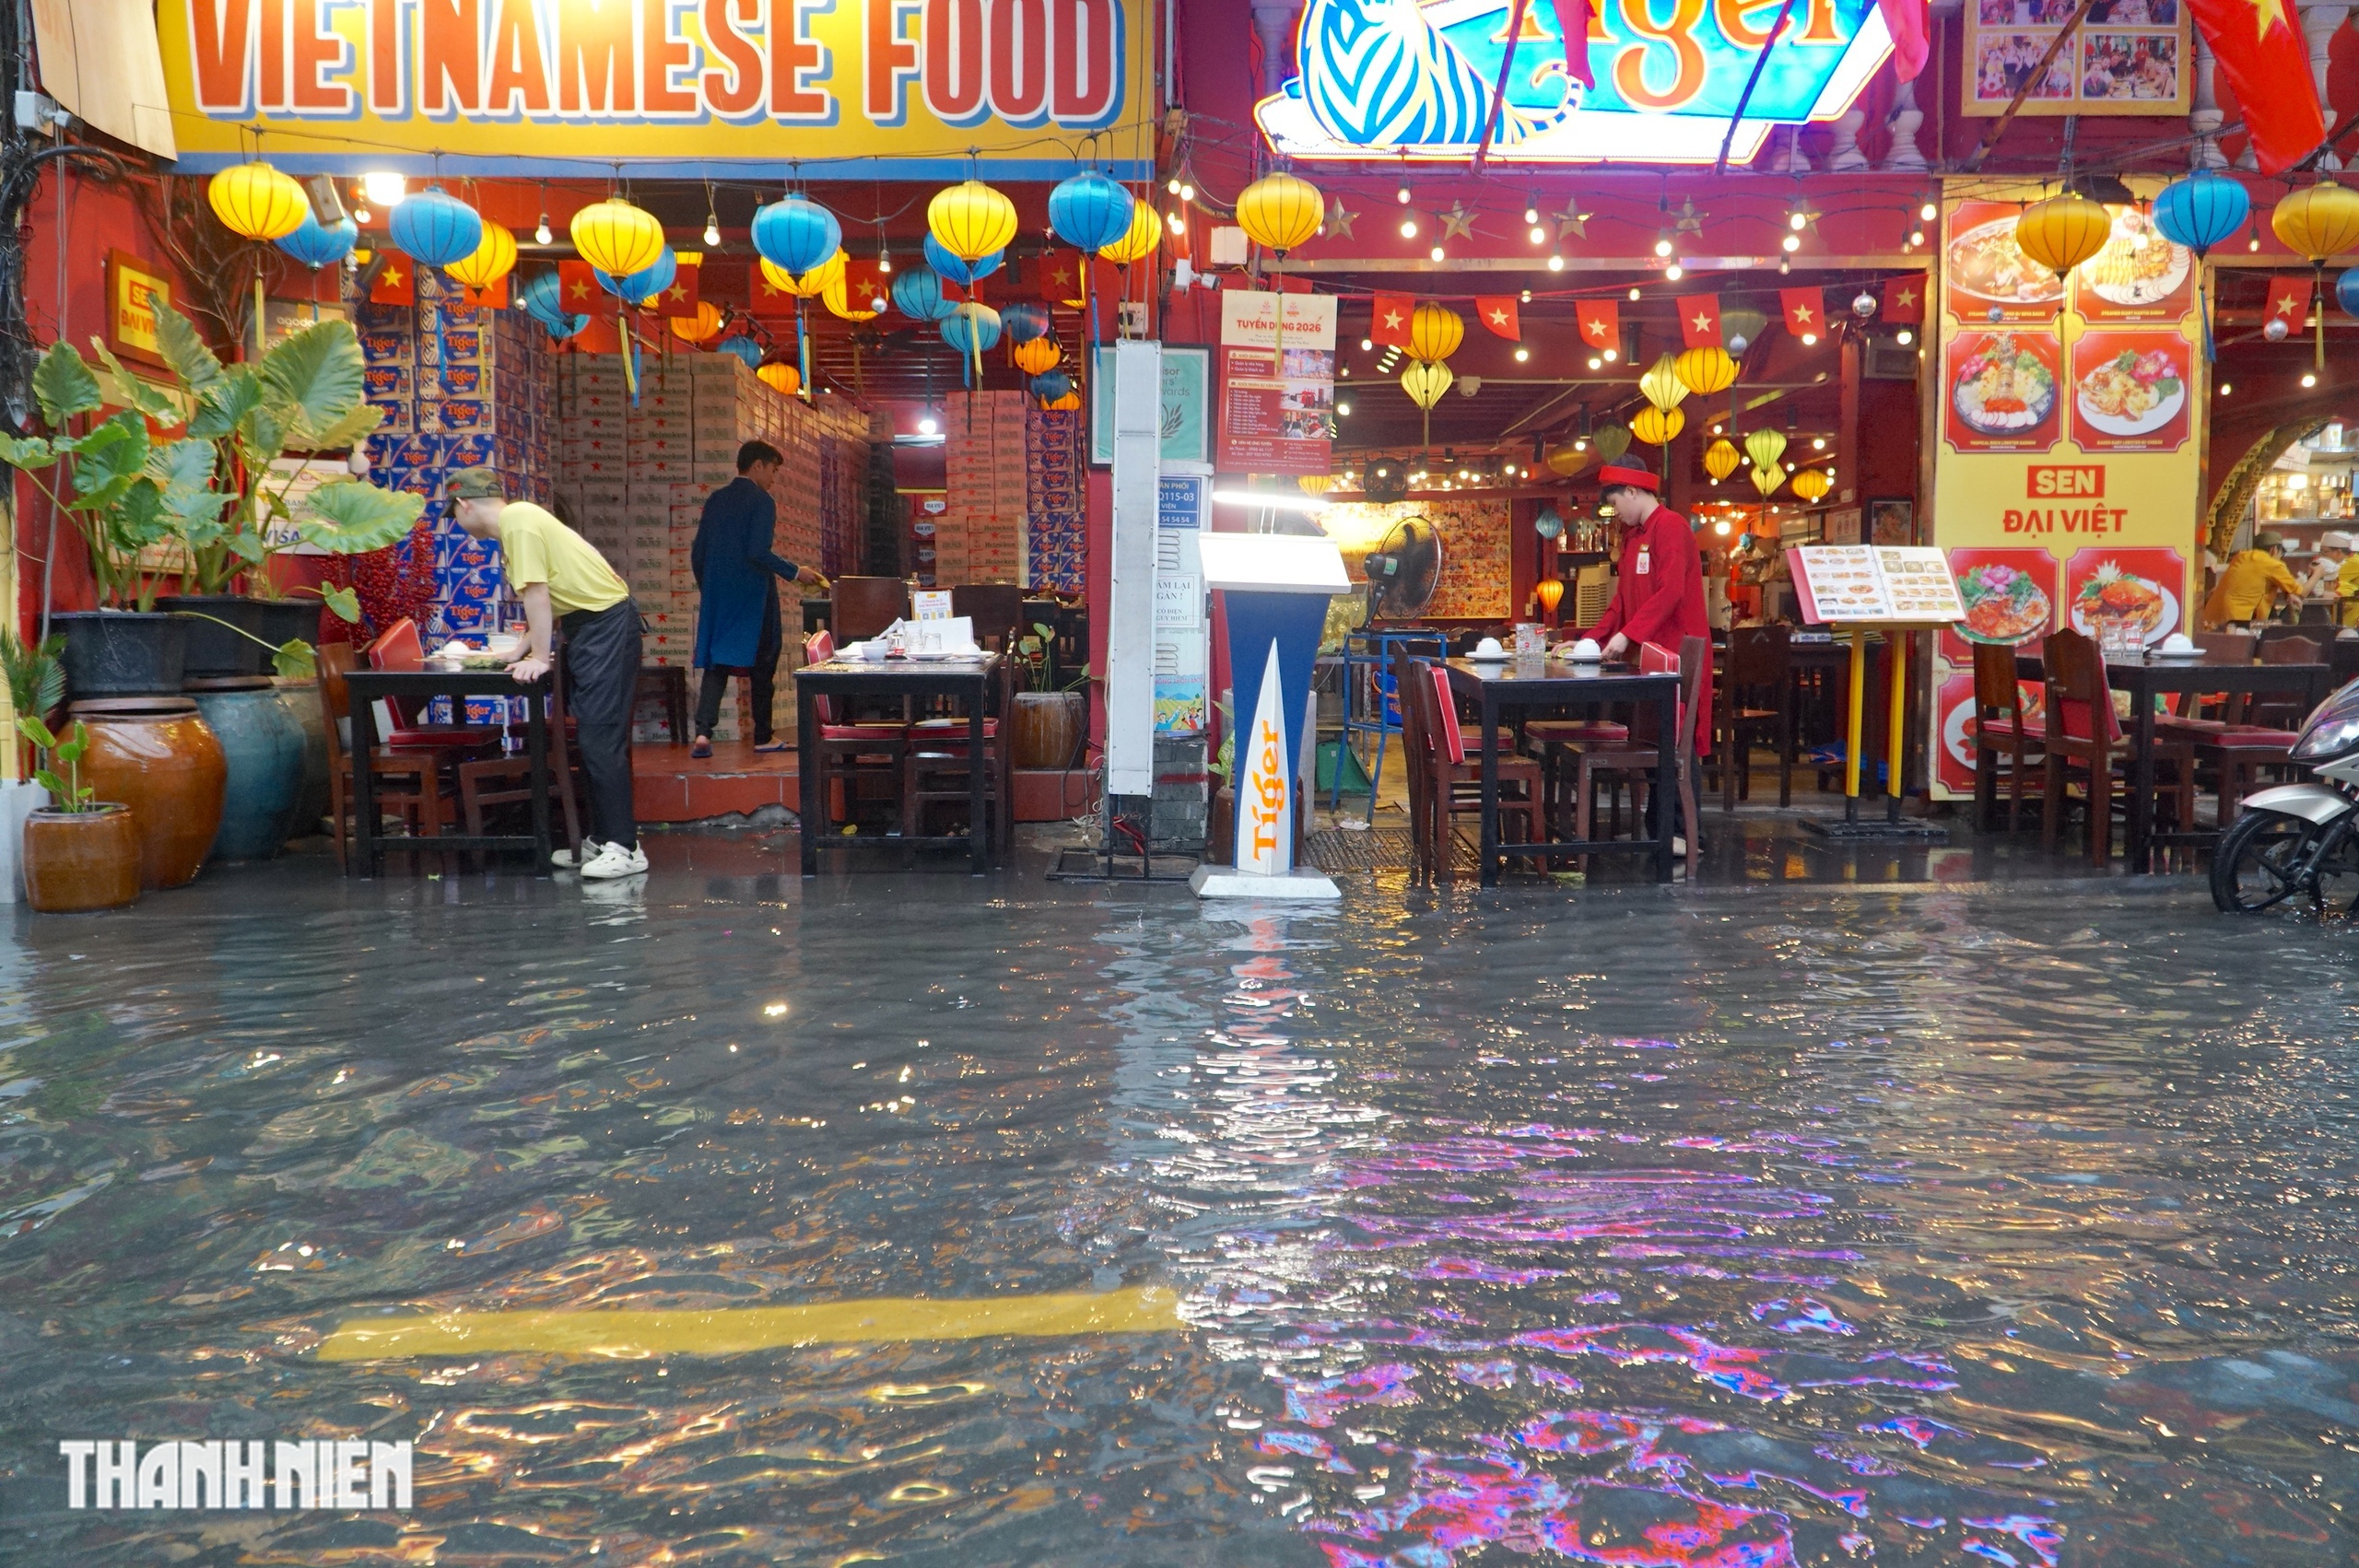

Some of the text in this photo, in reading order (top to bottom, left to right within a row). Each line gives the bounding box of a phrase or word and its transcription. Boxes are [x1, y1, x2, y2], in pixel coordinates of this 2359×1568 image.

[190, 0, 1117, 121] VIETNAMESE FOOD
[132, 285, 150, 308] SE
[1297, 322, 1321, 332] 2026
[2036, 469, 2095, 495] SEN
[2003, 502, 2128, 539] ĐẠI VIỆT
[451, 603, 481, 621] Tiger
[465, 703, 490, 719] iger
[1251, 720, 1285, 861] Tiger
